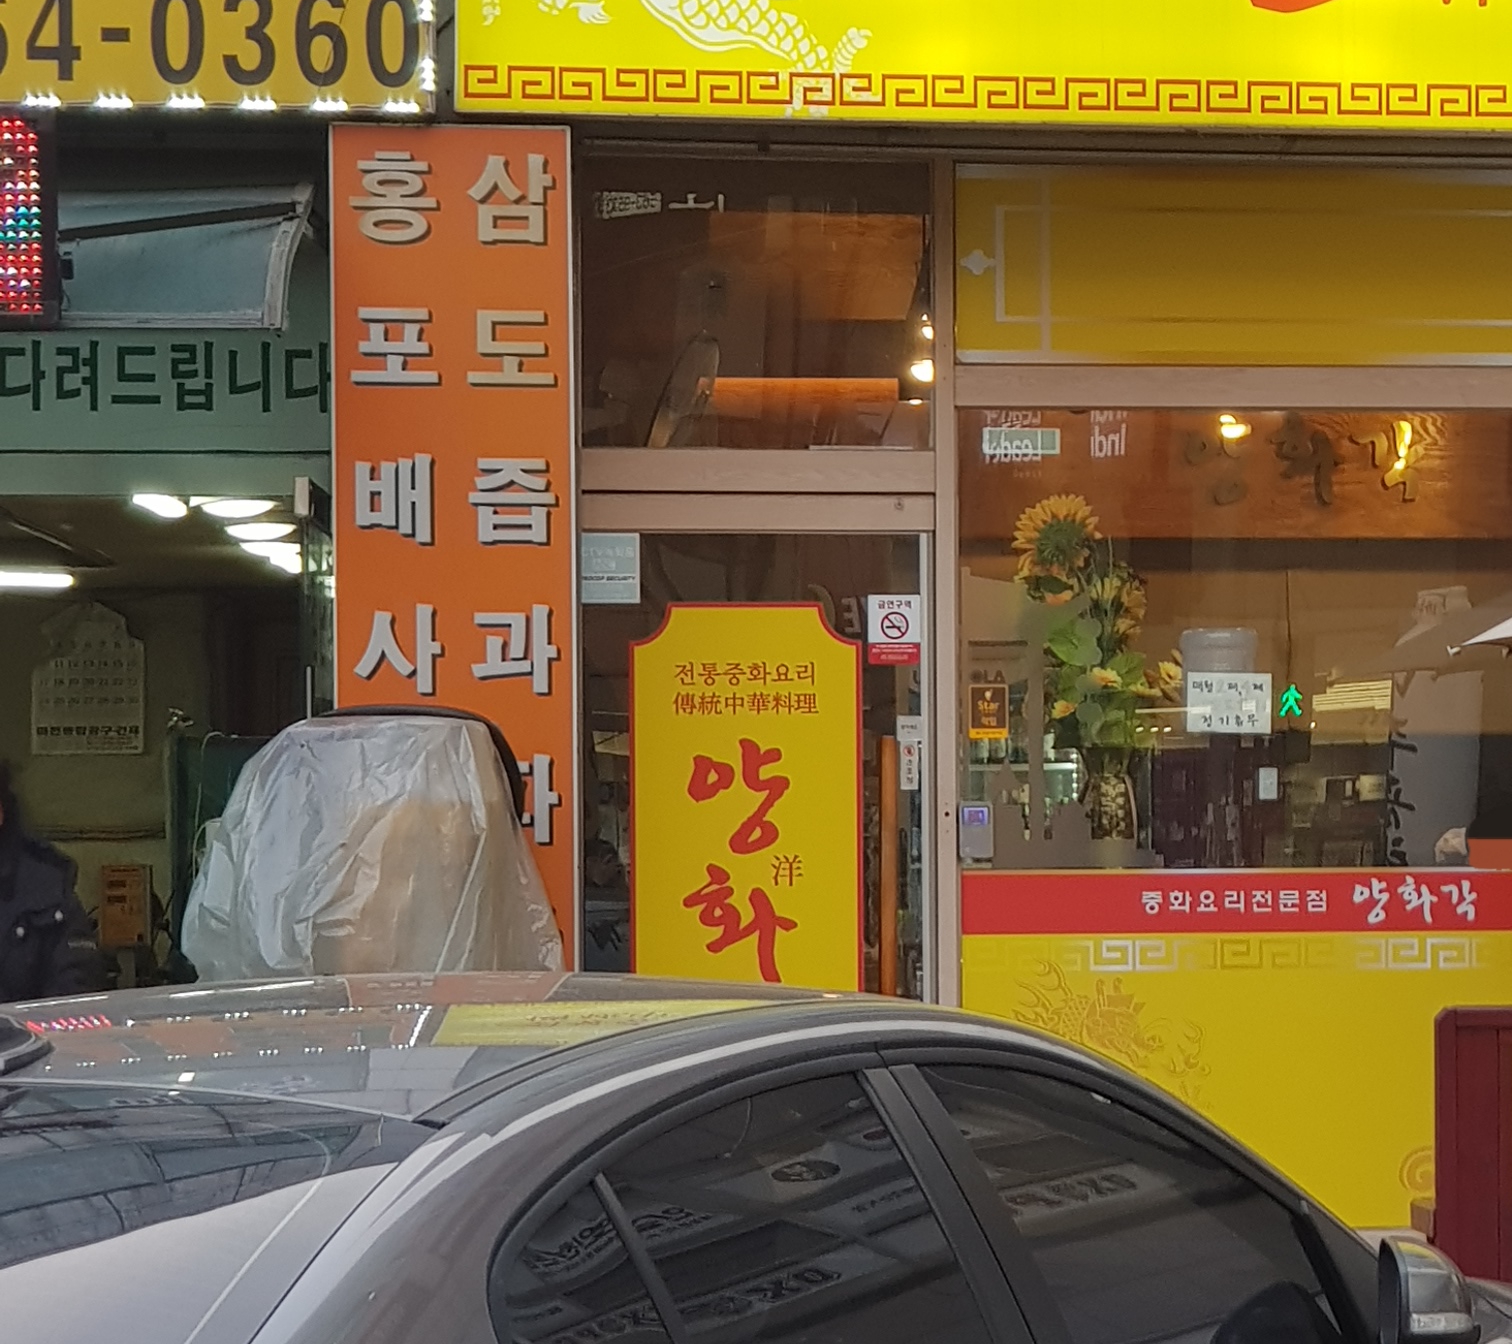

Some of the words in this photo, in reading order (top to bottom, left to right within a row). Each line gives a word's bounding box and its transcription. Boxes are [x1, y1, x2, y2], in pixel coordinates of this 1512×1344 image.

[349, 150, 557, 247] 홍삼
[0, 339, 331, 414] 다려드립니다
[350, 306, 557, 388] 포도
[353, 453, 557, 546] 배즙
[353, 603, 559, 696] 사과
[673, 661, 817, 688] 전통중화요리
[672, 691, 820, 716] 傳統中華料理
[1141, 888, 1328, 914] 중화요리전문점
[1352, 874, 1479, 923] 양화각
